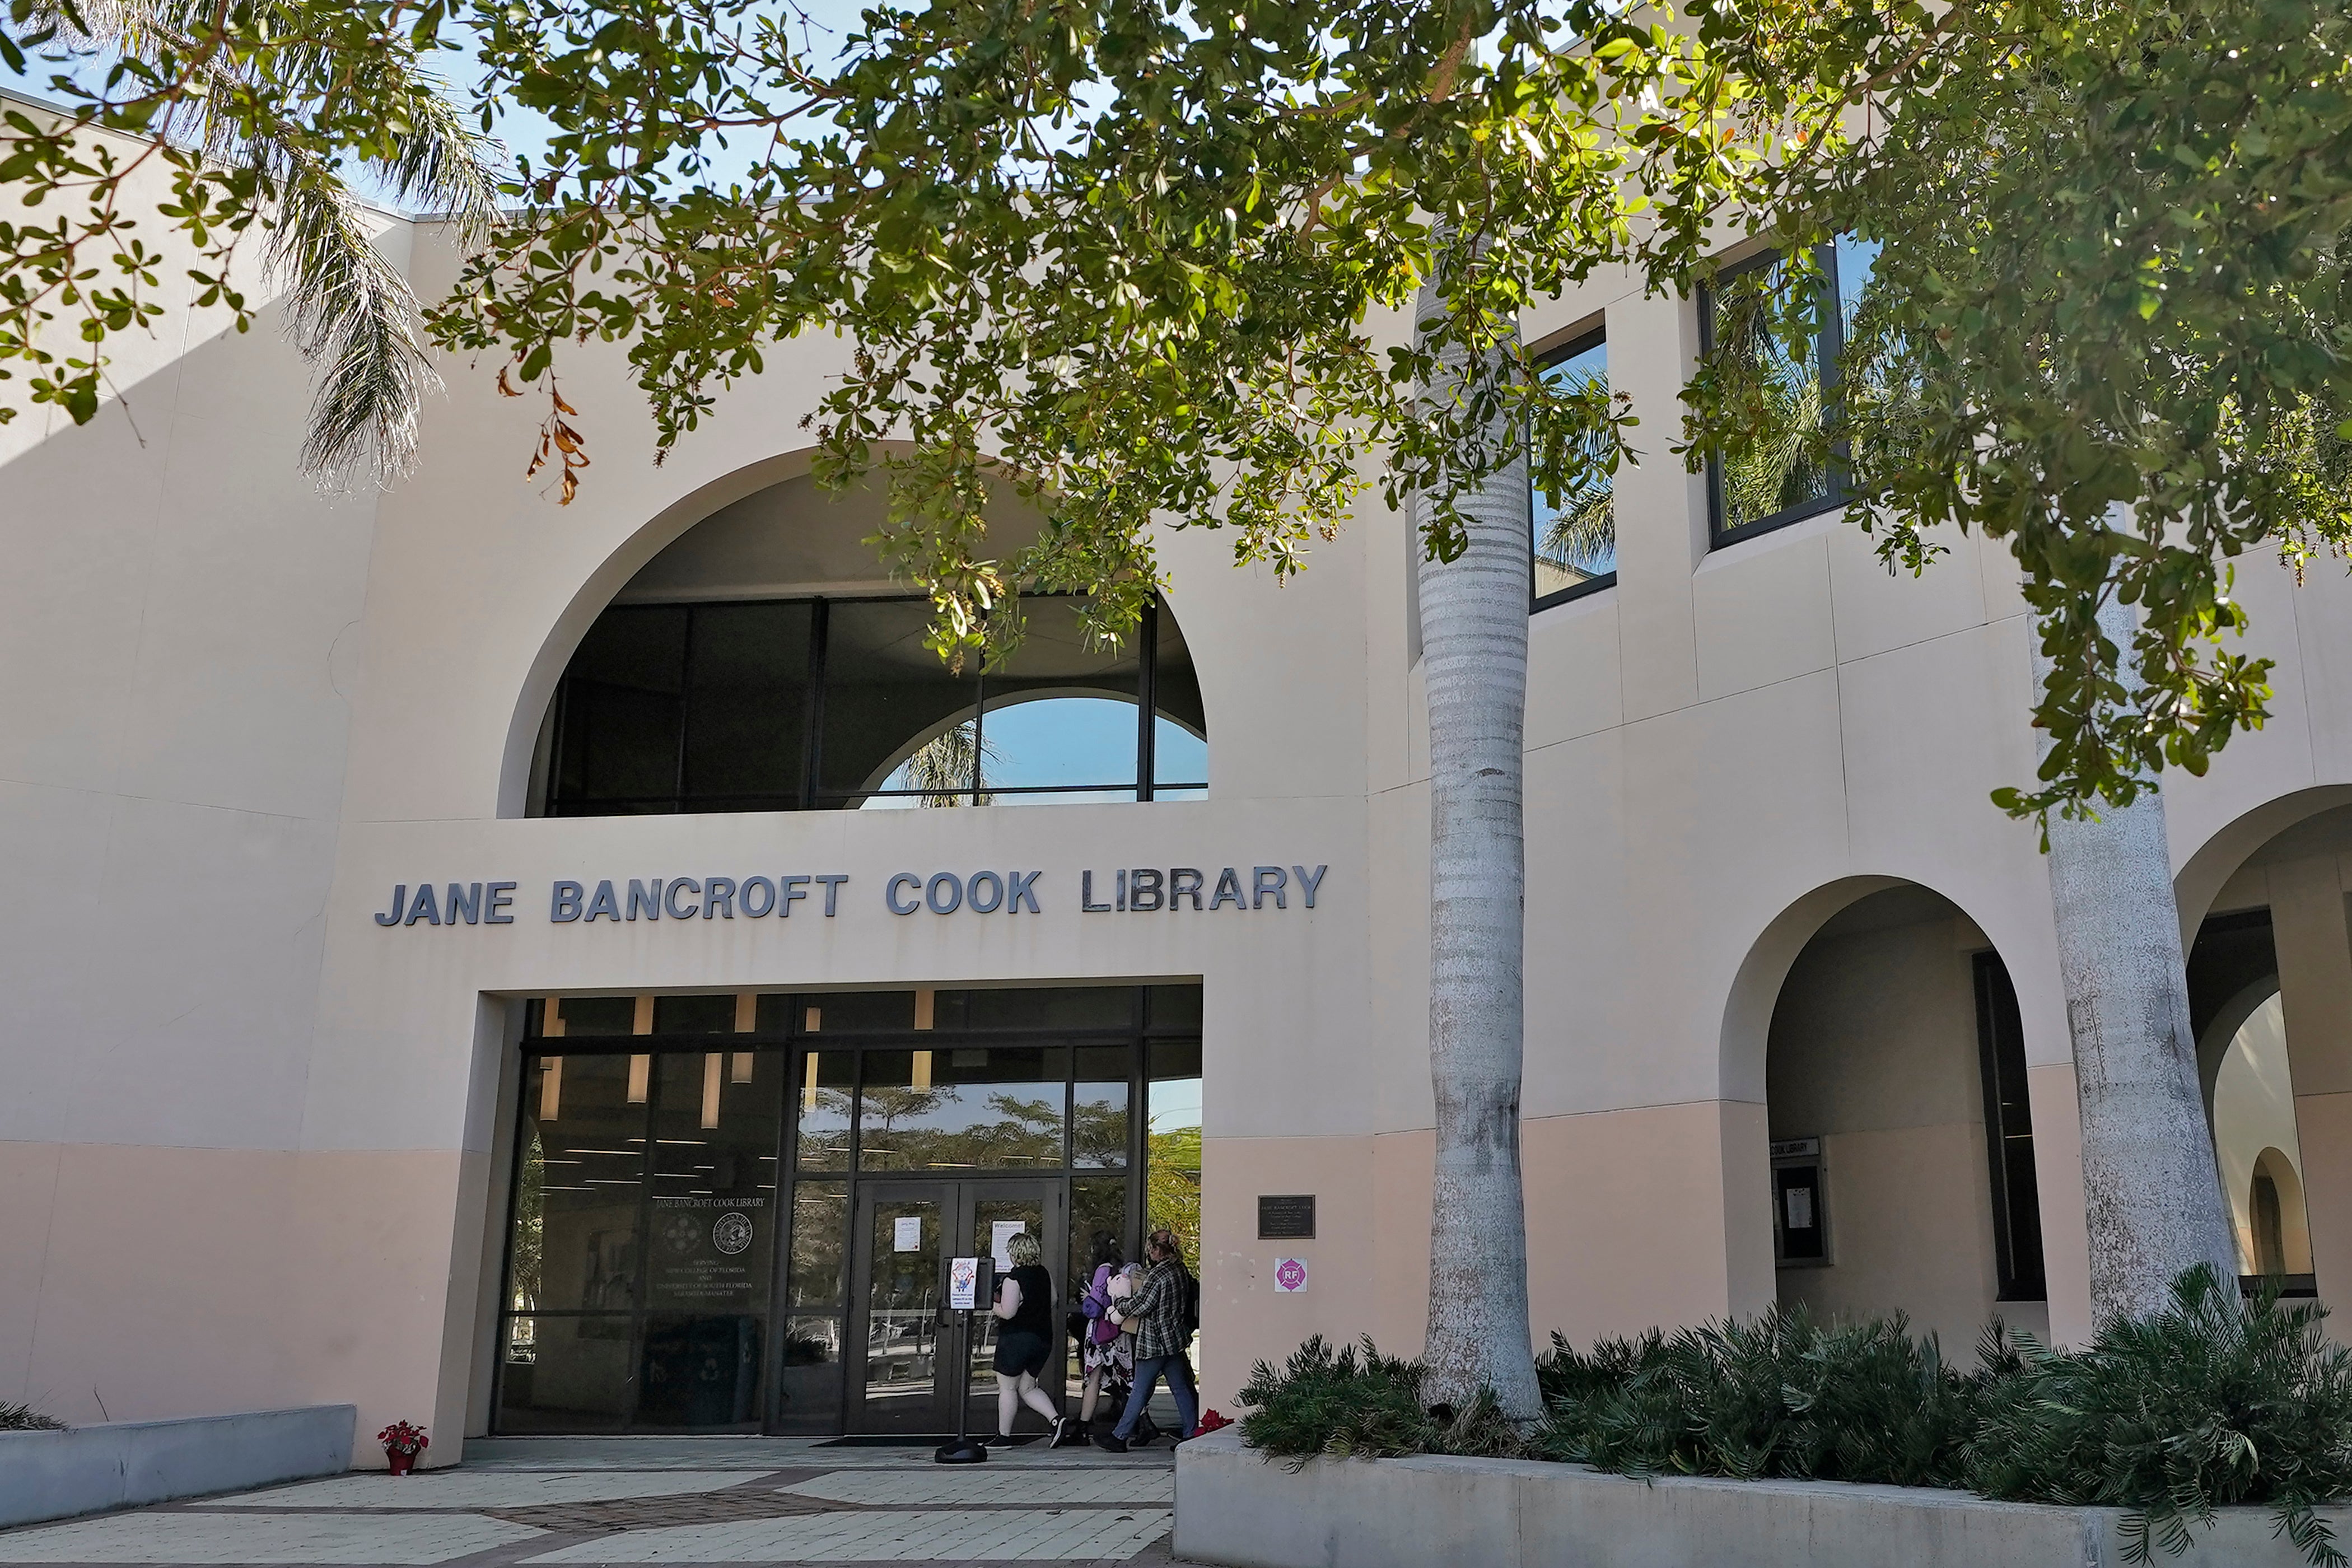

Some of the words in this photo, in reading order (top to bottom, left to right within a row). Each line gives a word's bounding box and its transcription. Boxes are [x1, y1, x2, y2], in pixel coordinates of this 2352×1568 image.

[375, 881, 517, 928] JANE
[550, 875, 849, 924] BANCROFT
[886, 871, 1043, 916] COOK
[1082, 865, 1328, 913] LIBRARY
[656, 1200, 673, 1208] JANE
[674, 1198, 712, 1208] BANCROFT
[713, 1198, 736, 1207] COOK
[736, 1197, 765, 1207] LIBRARY
[1285, 1271, 1298, 1279] RF
